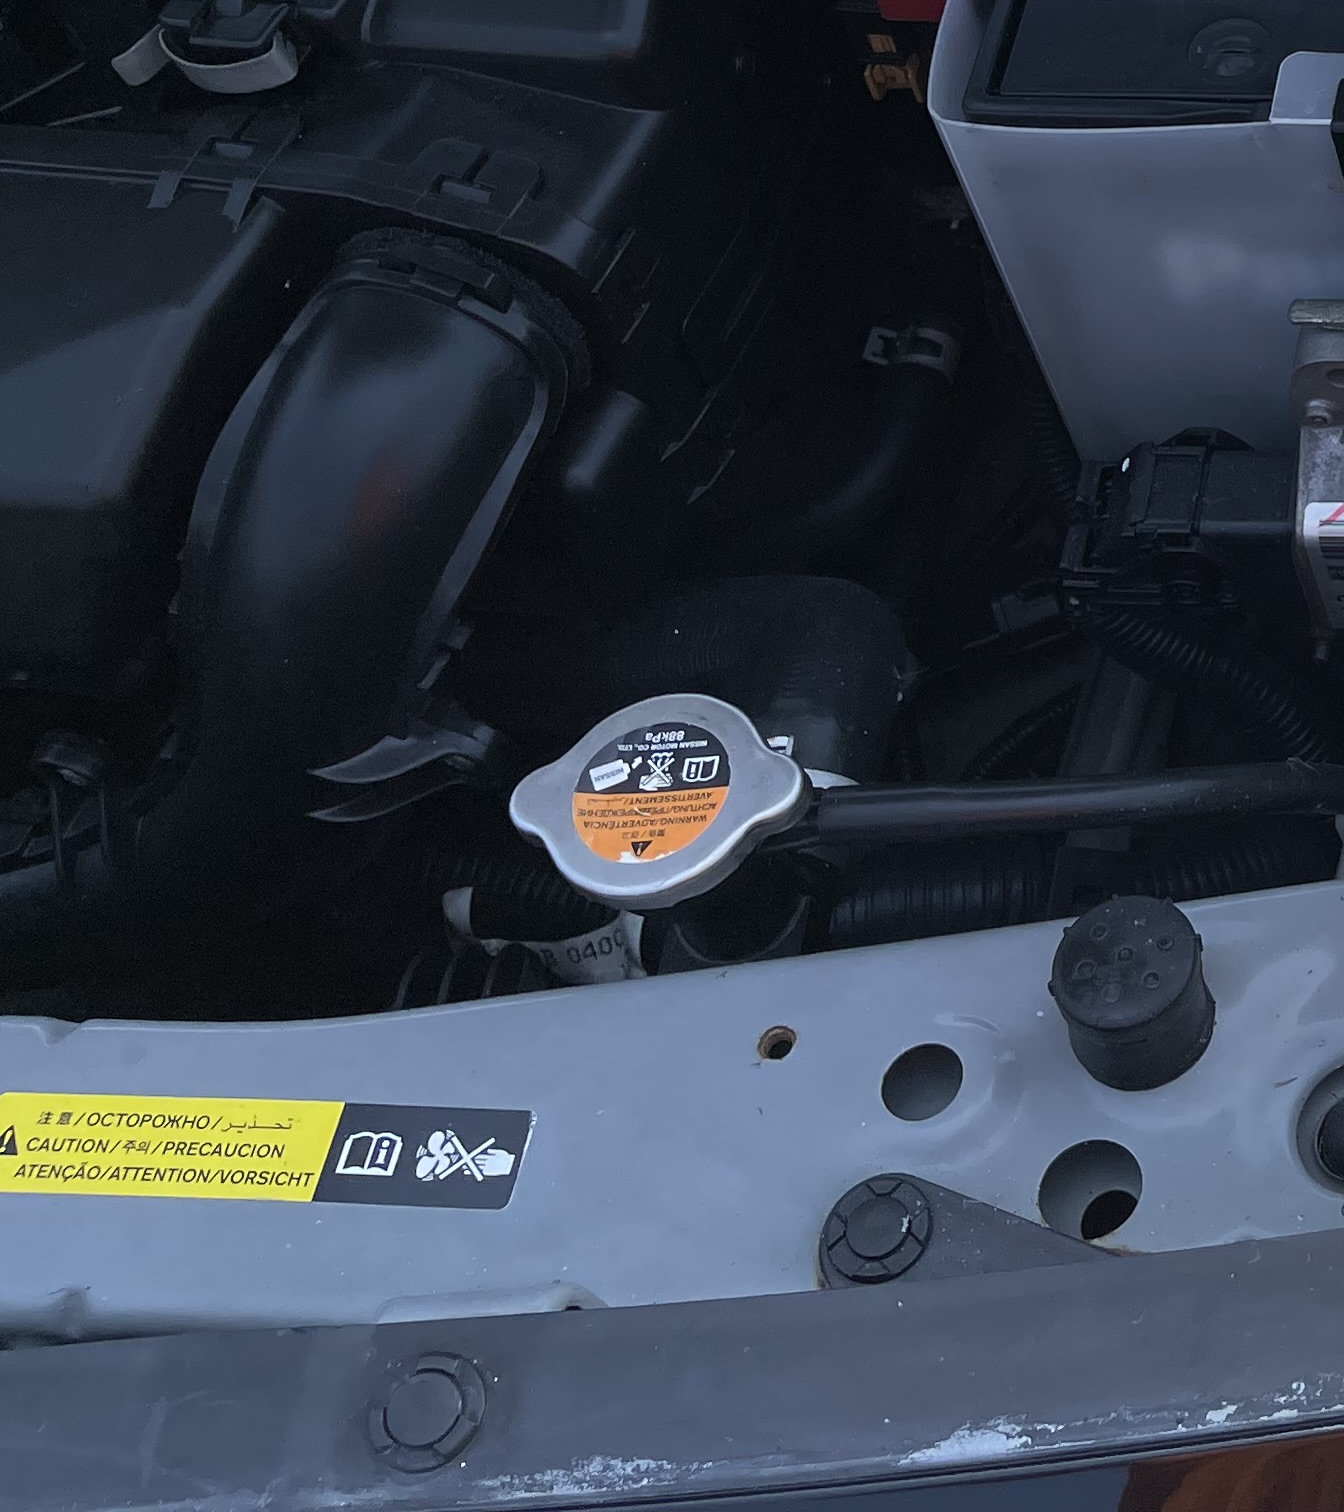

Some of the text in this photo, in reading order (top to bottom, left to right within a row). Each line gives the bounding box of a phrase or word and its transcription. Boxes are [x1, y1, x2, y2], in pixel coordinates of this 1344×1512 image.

[645, 729, 685, 743] 88kPa
[650, 741, 679, 751] MOTOR
[679, 739, 708, 750] NISSAN
